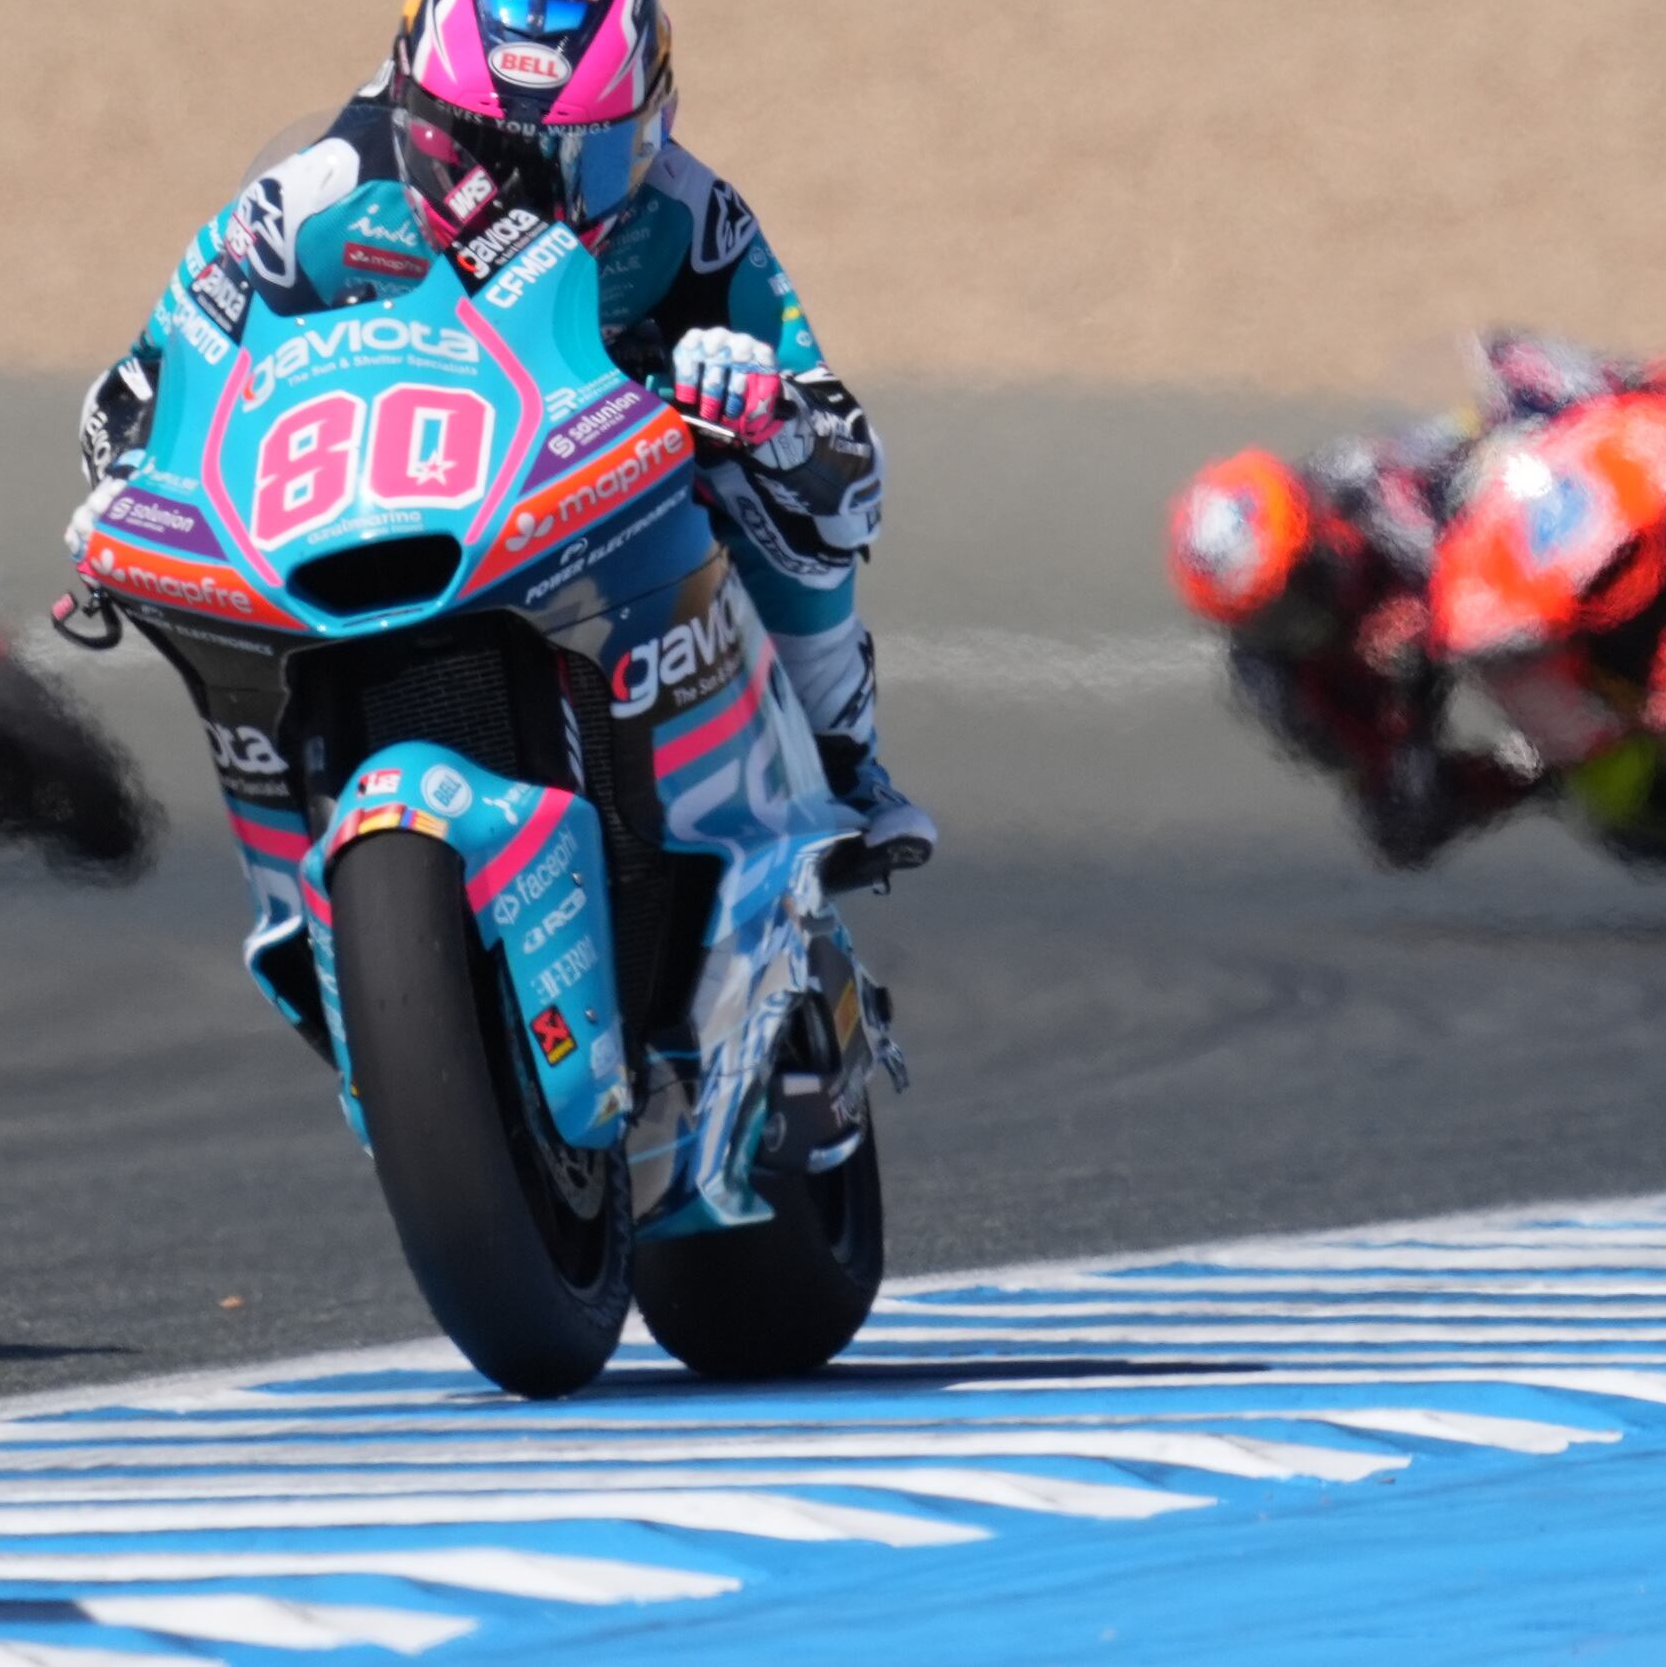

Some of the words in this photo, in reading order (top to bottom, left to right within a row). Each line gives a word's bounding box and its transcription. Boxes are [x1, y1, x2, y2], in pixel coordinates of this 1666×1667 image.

[499, 52, 560, 79] BELL
[485, 226, 580, 309] CFMOTO
[242, 317, 480, 413] gaviota
[353, 352, 404, 368] Shutter
[406, 353, 479, 377] Specialists
[568, 390, 643, 444] solunion
[250, 381, 496, 552] 80
[558, 428, 686, 522] mapfre
[131, 502, 196, 533] solunion
[128, 566, 254, 614] mapfre
